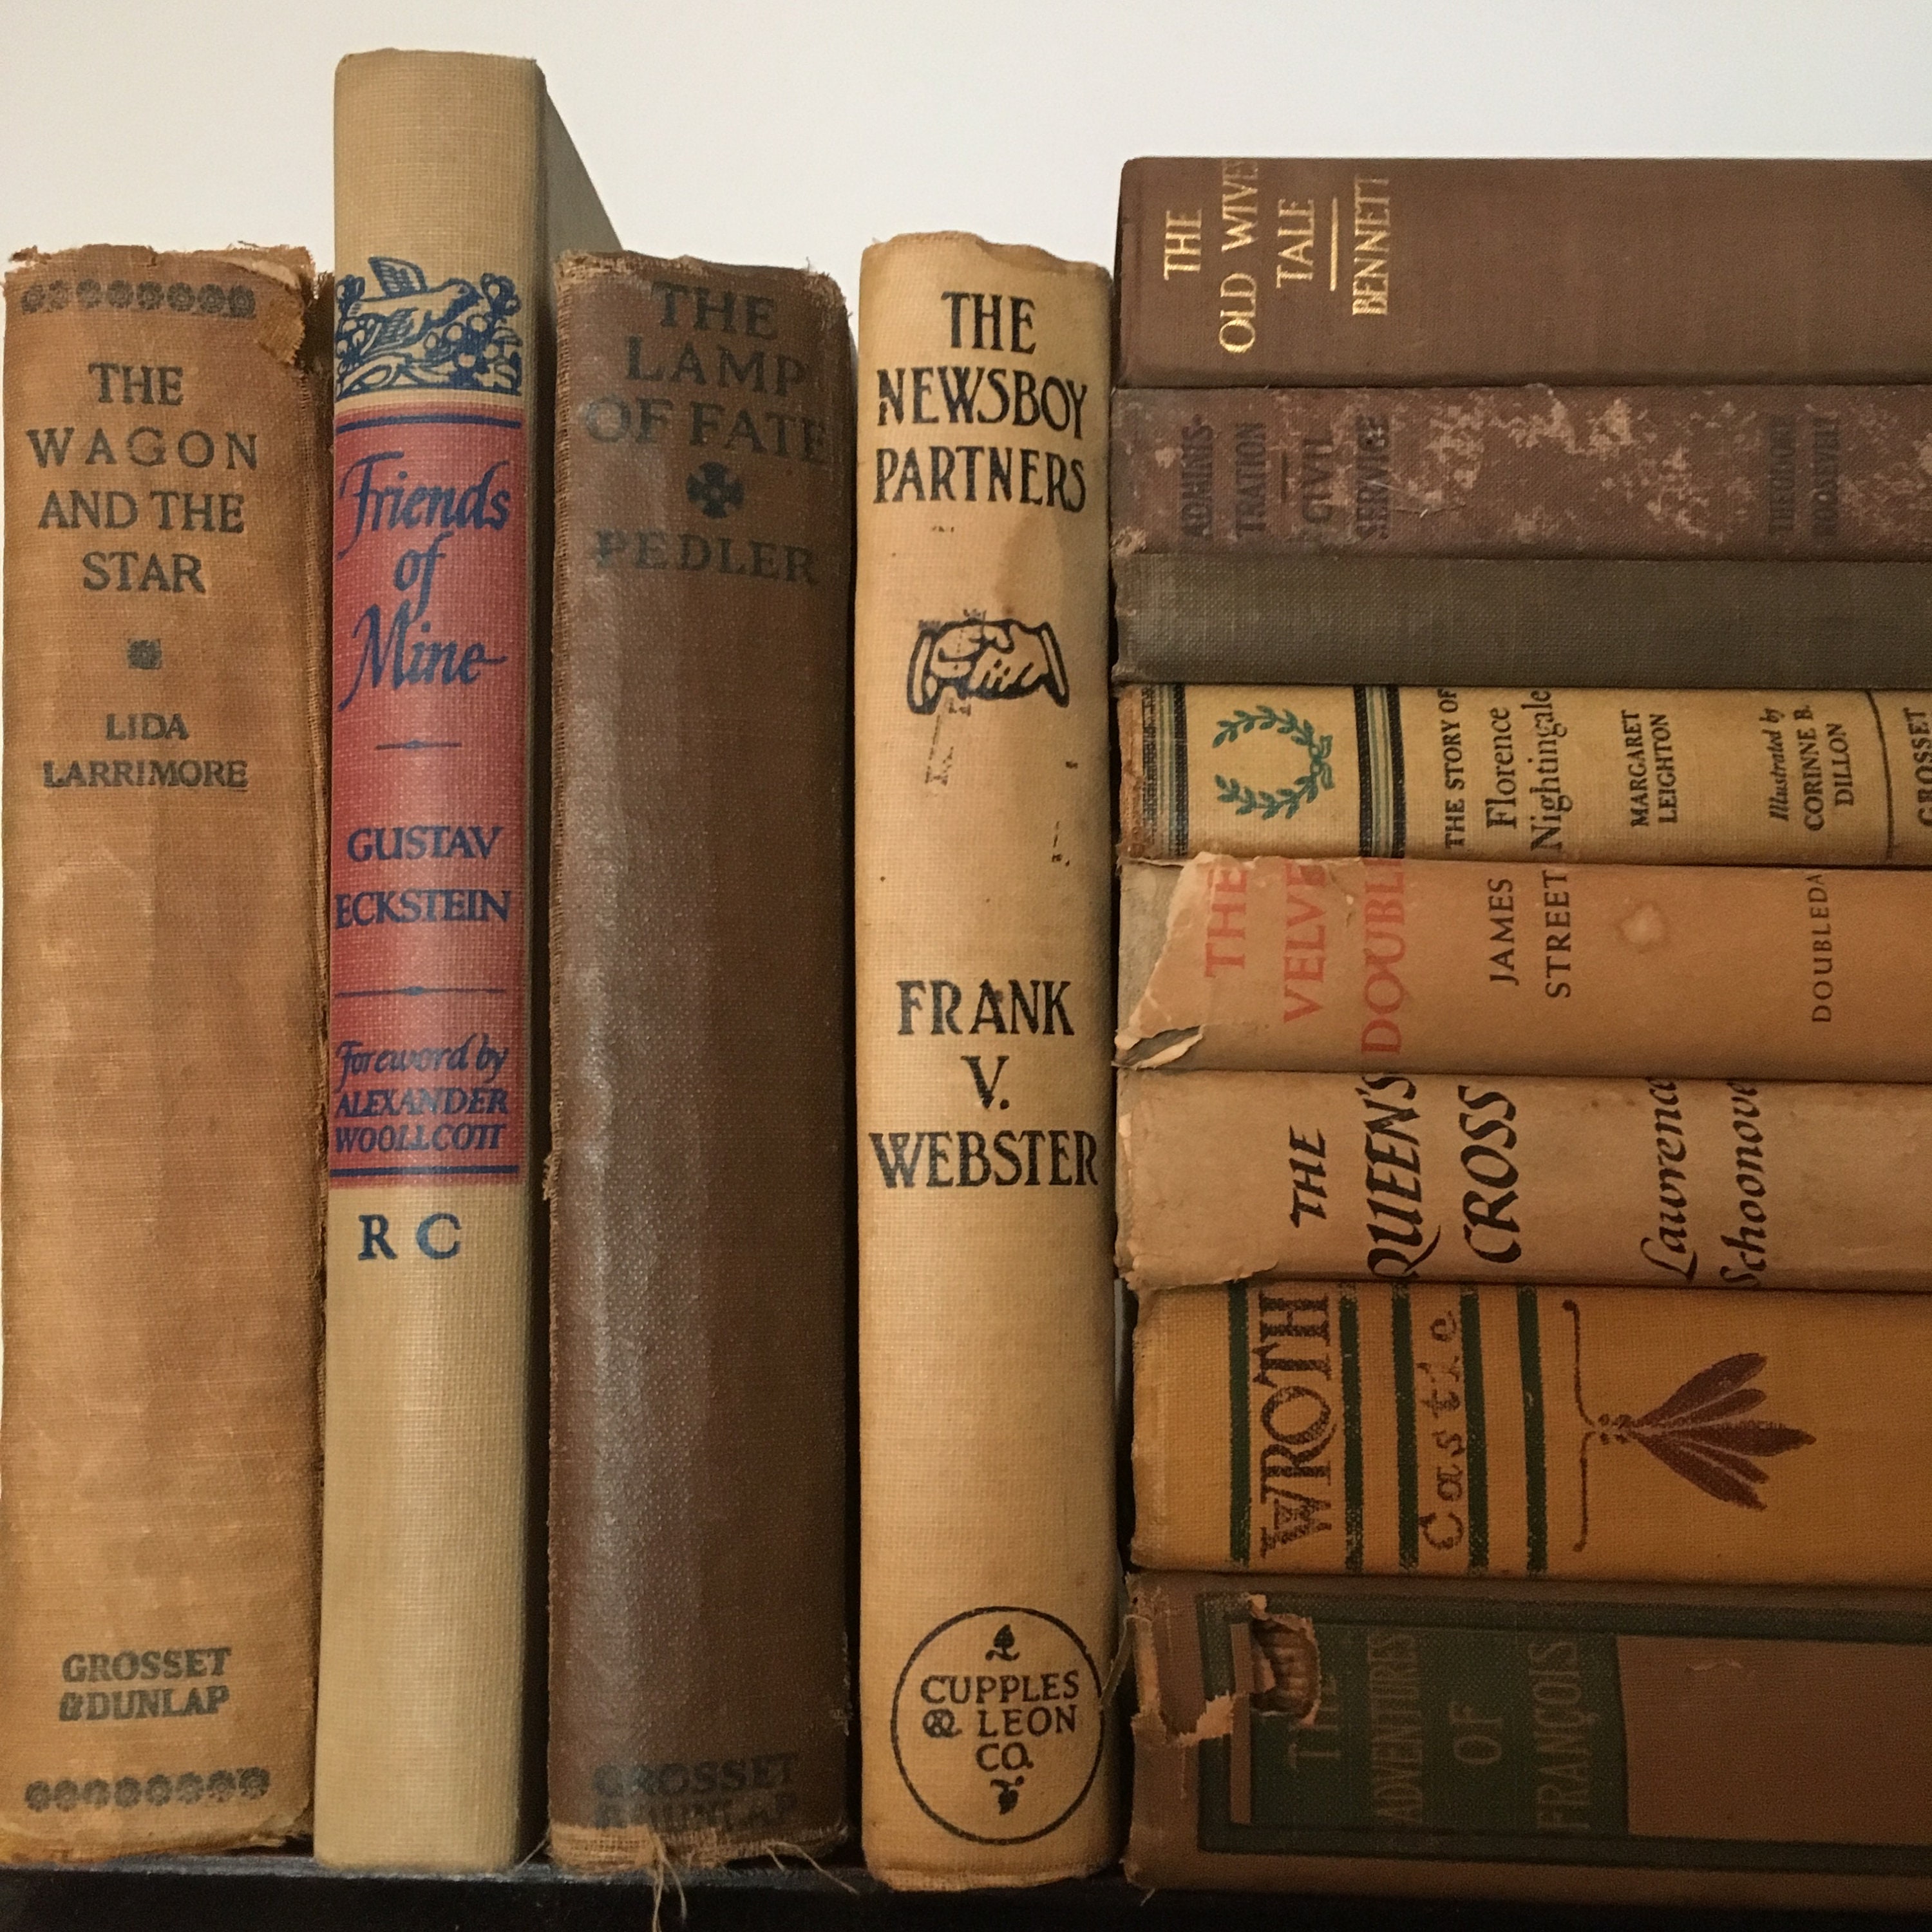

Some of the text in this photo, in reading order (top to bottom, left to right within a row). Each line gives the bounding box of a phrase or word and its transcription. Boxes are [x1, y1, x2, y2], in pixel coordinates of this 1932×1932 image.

[1164, 208, 1202, 281] THE
[1276, 197, 1314, 289] TALE
[1352, 173, 1391, 316] BENNETT
[651, 280, 779, 341] THE
[941, 291, 1036, 354] THE
[1218, 272, 1257, 354] OLD
[89, 362, 184, 405] THE
[624, 334, 806, 397] LAMP
[584, 393, 829, 464] OF FATE
[876, 365, 1088, 440] NEWSBOY
[26, 426, 259, 470] WAGON
[873, 445, 1087, 513] PARTNERS
[37, 490, 246, 535] AND THE
[337, 450, 513, 562] Friends
[82, 551, 207, 594] STAR
[392, 531, 453, 623] of
[592, 528, 819, 587] PEDLER
[337, 598, 508, 712] Mine
[106, 713, 189, 741] LIDA
[43, 759, 249, 790] LARRIMORE
[1437, 688, 1466, 850] THE STORY OF
[1484, 706, 1518, 829] Florence
[1520, 687, 1573, 852] Nightingale
[1621, 708, 1650, 828] MARGARET
[1649, 713, 1678, 825] LEIGHTON
[1758, 708, 1790, 822] Illustrated by
[1796, 726, 1826, 832] CORINNE
[1826, 722, 1855, 807] DILLON
[346, 825, 504, 863] GUSTAV
[334, 889, 512, 930] ECKSTEIN
[1204, 867, 1247, 978] THE
[1487, 878, 1520, 987] JAMES
[1541, 869, 1572, 999] STREET
[896, 978, 1074, 1036] FRANK
[477, 1033, 509, 1083] by
[960, 1055, 1010, 1110] V.
[334, 1086, 509, 1119] ALEXANDER
[334, 1122, 507, 1155] WOOLLCOTT
[868, 1130, 1099, 1188] WEBSTER
[1289, 1124, 1328, 1228] THE
[1355, 1074, 1441, 1278] QUEEN'S
[1457, 1084, 1522, 1264] CROSS
[1252, 1293, 1338, 1559] WROTH
[62, 1647, 232, 1683] GROSSET
[920, 1669, 1080, 1705] CUPPLES
[977, 1704, 1077, 1738] LEON
[1366, 1629, 1424, 1824] ADVENTURES
[1448, 1699, 1504, 1766] OF
